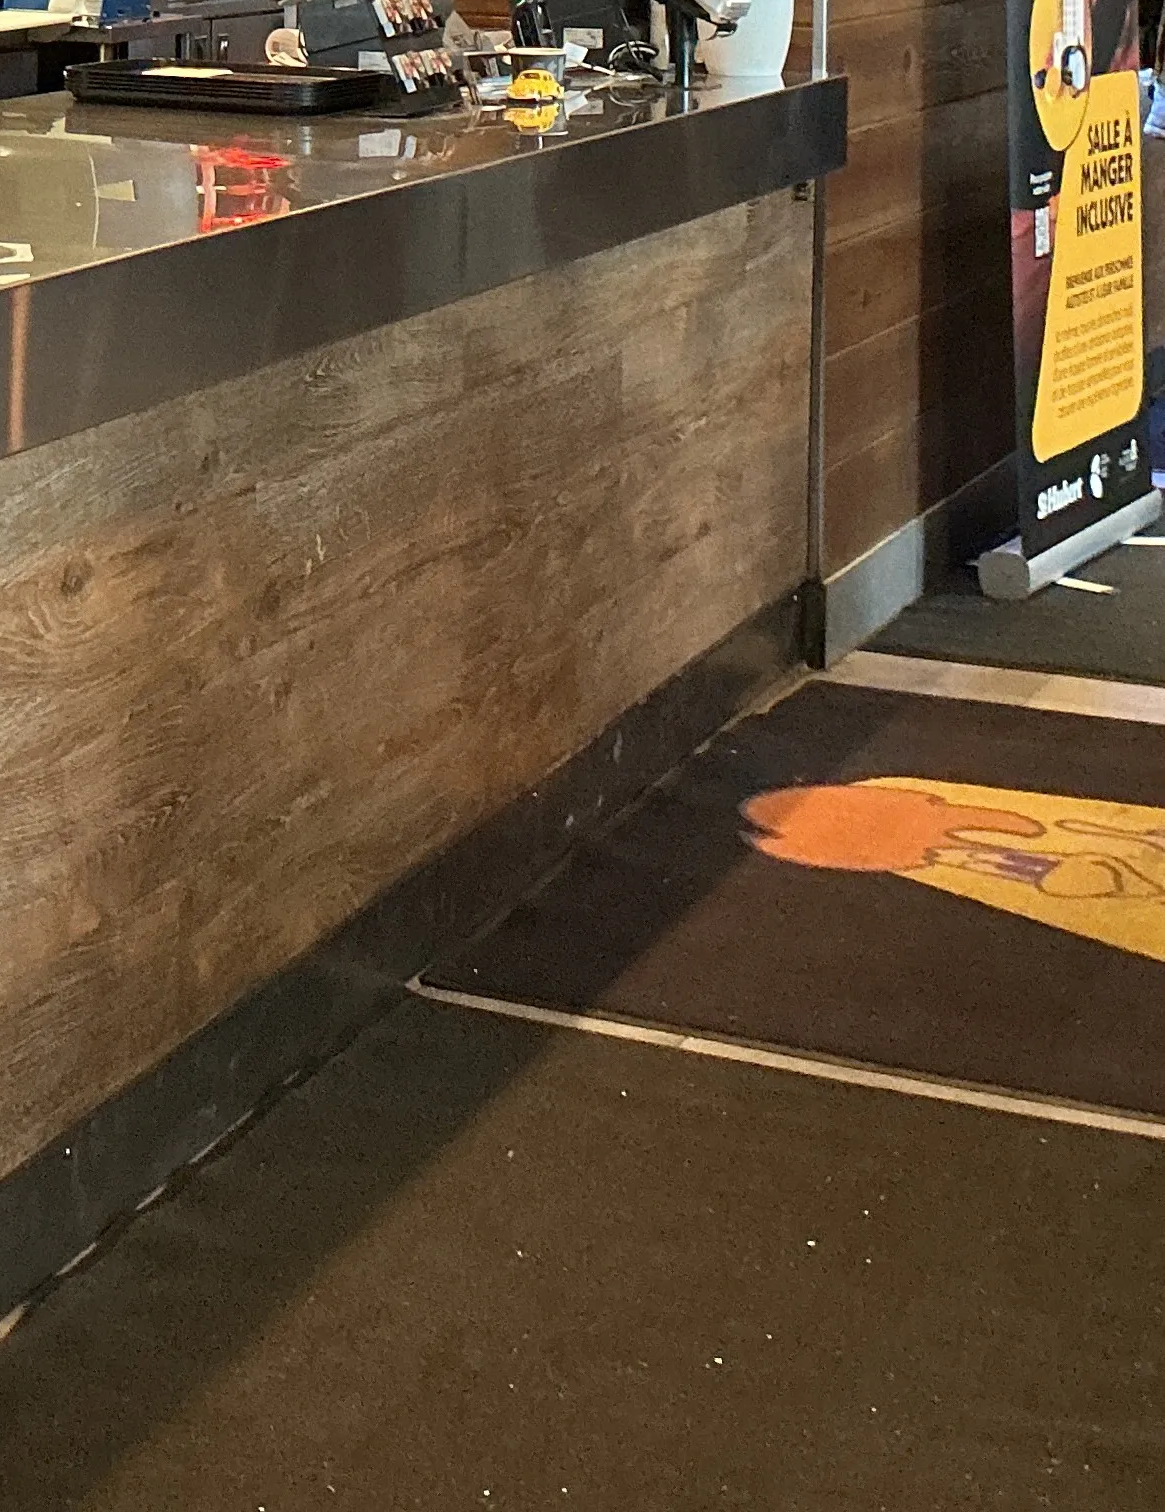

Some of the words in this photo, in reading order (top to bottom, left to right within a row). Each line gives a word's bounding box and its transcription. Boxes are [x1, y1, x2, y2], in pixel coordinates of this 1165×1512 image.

[1087, 119, 1120, 156] SALLE
[1123, 110, 1133, 148] À
[1080, 152, 1133, 195] MANGER
[1076, 191, 1134, 237] INCLUSIVE
